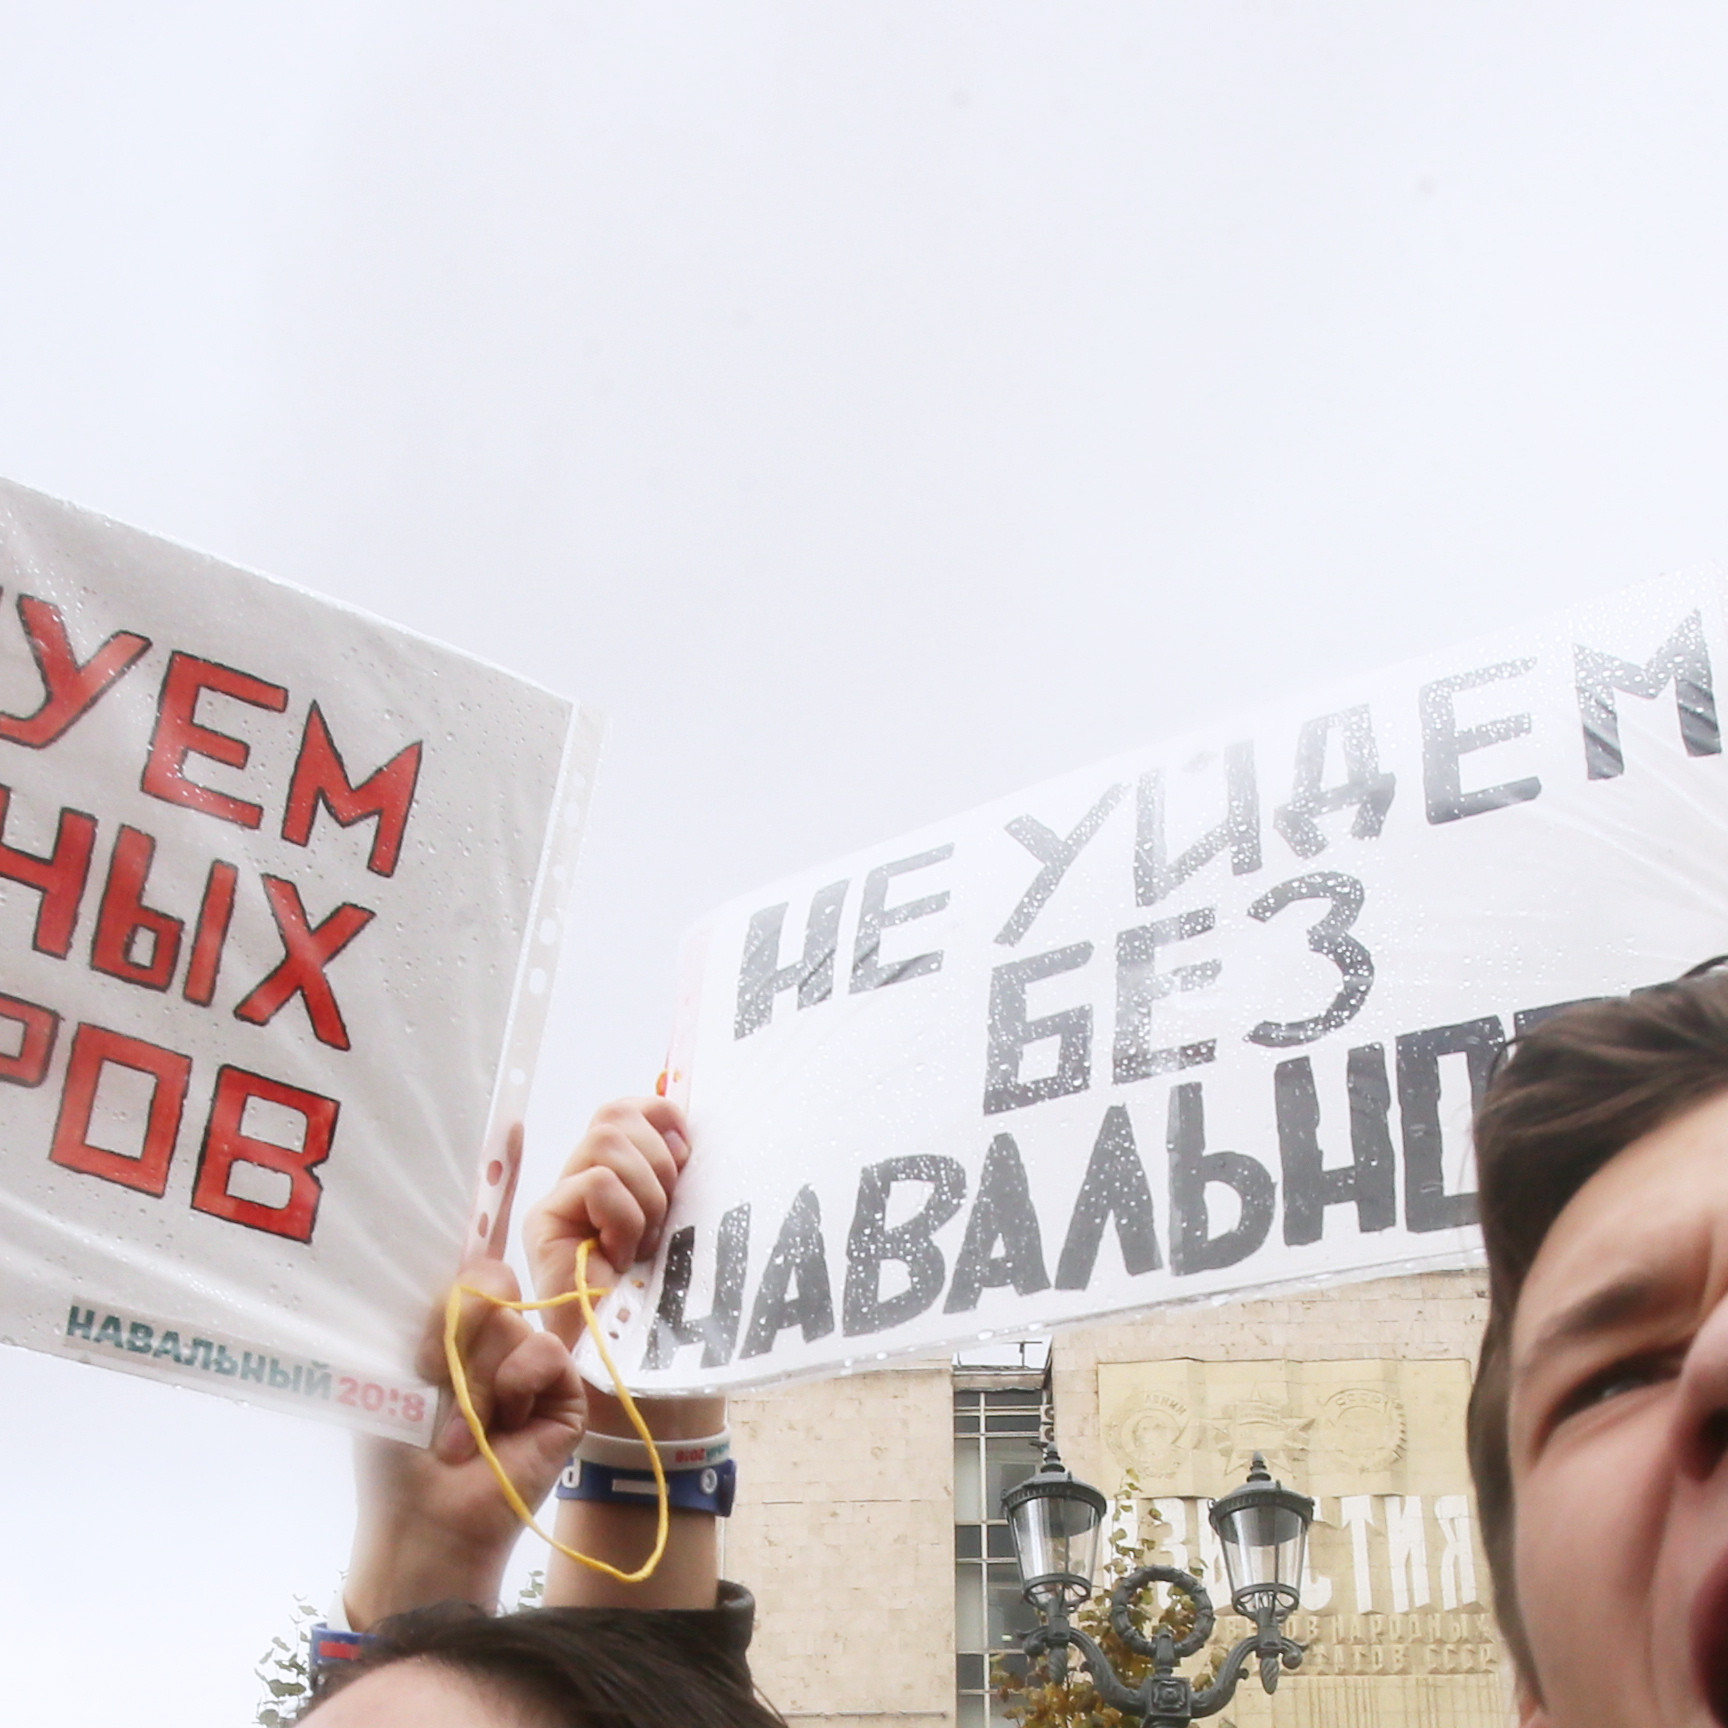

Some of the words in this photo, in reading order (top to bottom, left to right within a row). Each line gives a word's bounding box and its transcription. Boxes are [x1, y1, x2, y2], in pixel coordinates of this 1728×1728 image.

[733, 842, 954, 1041] НЕ
[984, 871, 1374, 1115] БЕЗ
[639, 997, 1632, 1372] НАВАЛЬНО
[67, 1304, 333, 1400] НАВАЛЬНЫЙ
